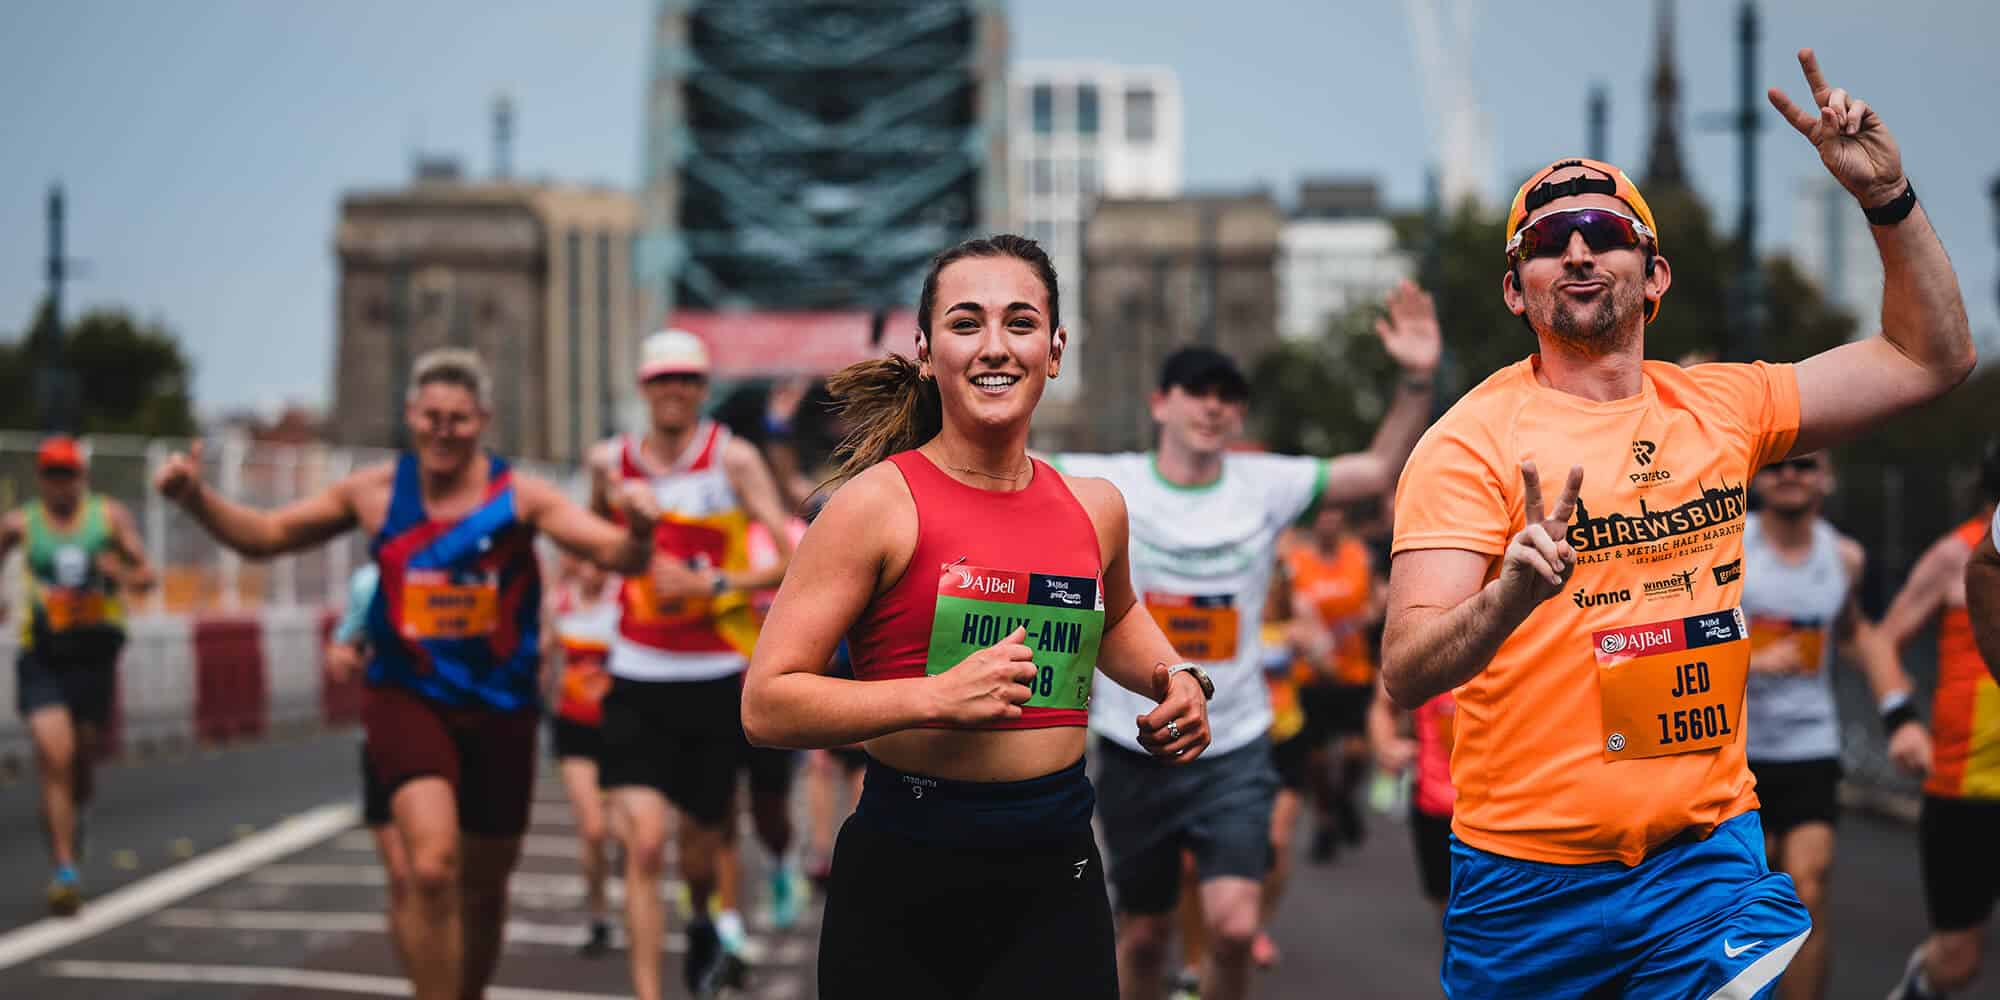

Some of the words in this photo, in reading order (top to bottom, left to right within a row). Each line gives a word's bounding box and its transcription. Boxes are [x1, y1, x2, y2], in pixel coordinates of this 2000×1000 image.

[1630, 470, 1670, 482] Pareto
[1572, 493, 1743, 550] SHREWSBURY
[1577, 552, 1611, 565] HALF
[1615, 551, 1622, 559] &
[1627, 543, 1669, 557] METRIC
[1673, 534, 1699, 549] HALF
[971, 577, 1015, 595] AJBell
[1643, 577, 1682, 591] winner
[1572, 588, 1631, 608] Runna
[1627, 628, 1672, 650] AJBell
[1671, 661, 1711, 698] JED
[1657, 703, 1731, 745] 15601
